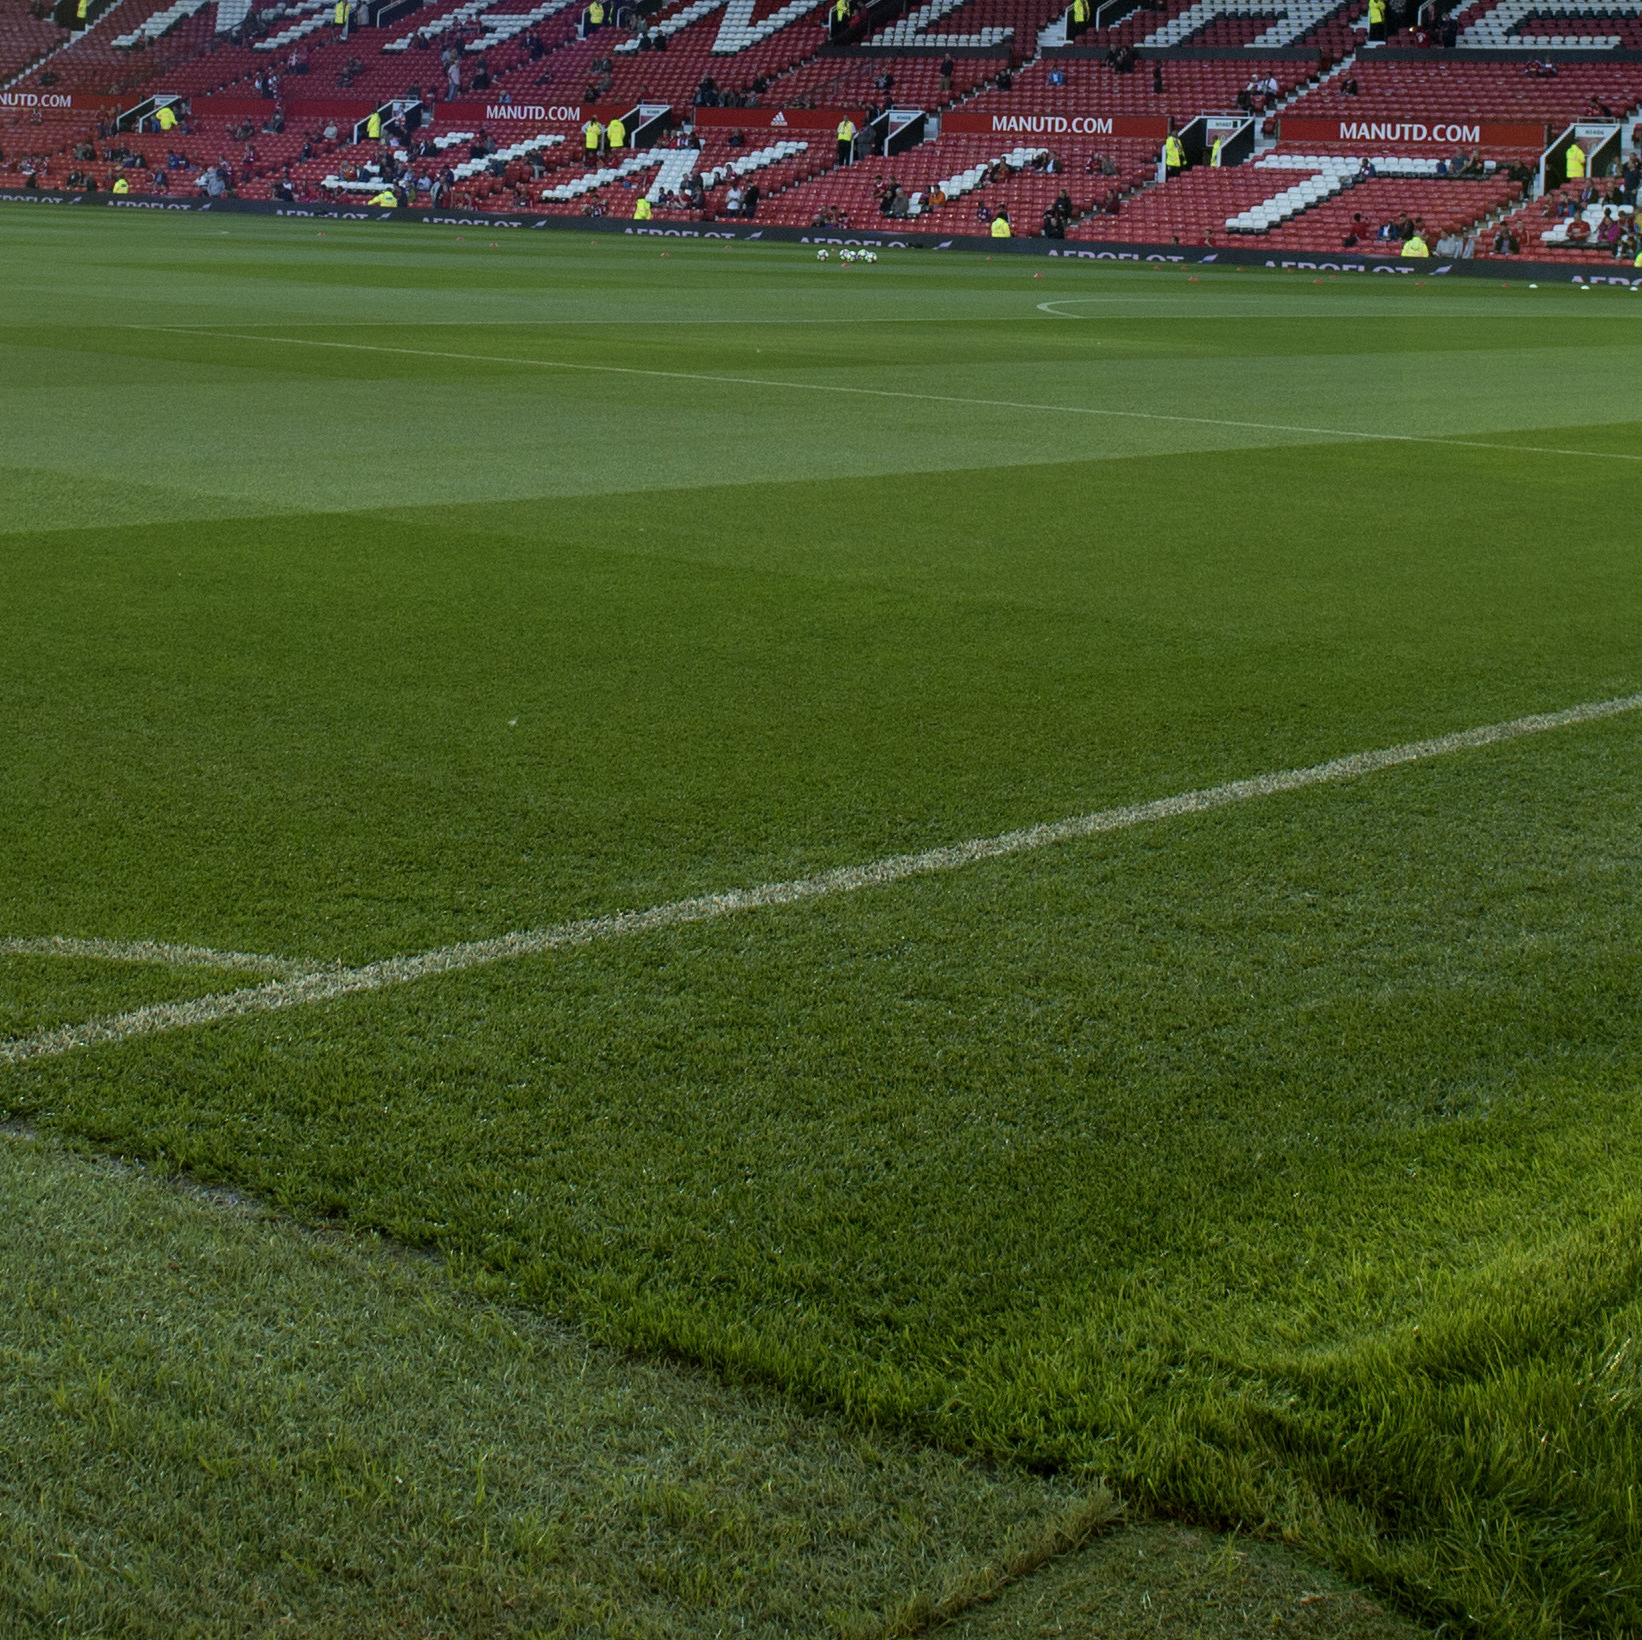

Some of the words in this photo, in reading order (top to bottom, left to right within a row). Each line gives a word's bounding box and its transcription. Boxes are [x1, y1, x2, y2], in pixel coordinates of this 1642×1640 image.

[485, 105, 581, 121] MANUTD.COM
[992, 115, 1113, 135] MANUTD.COM
[1339, 122, 1480, 143] MANUTD.COM
